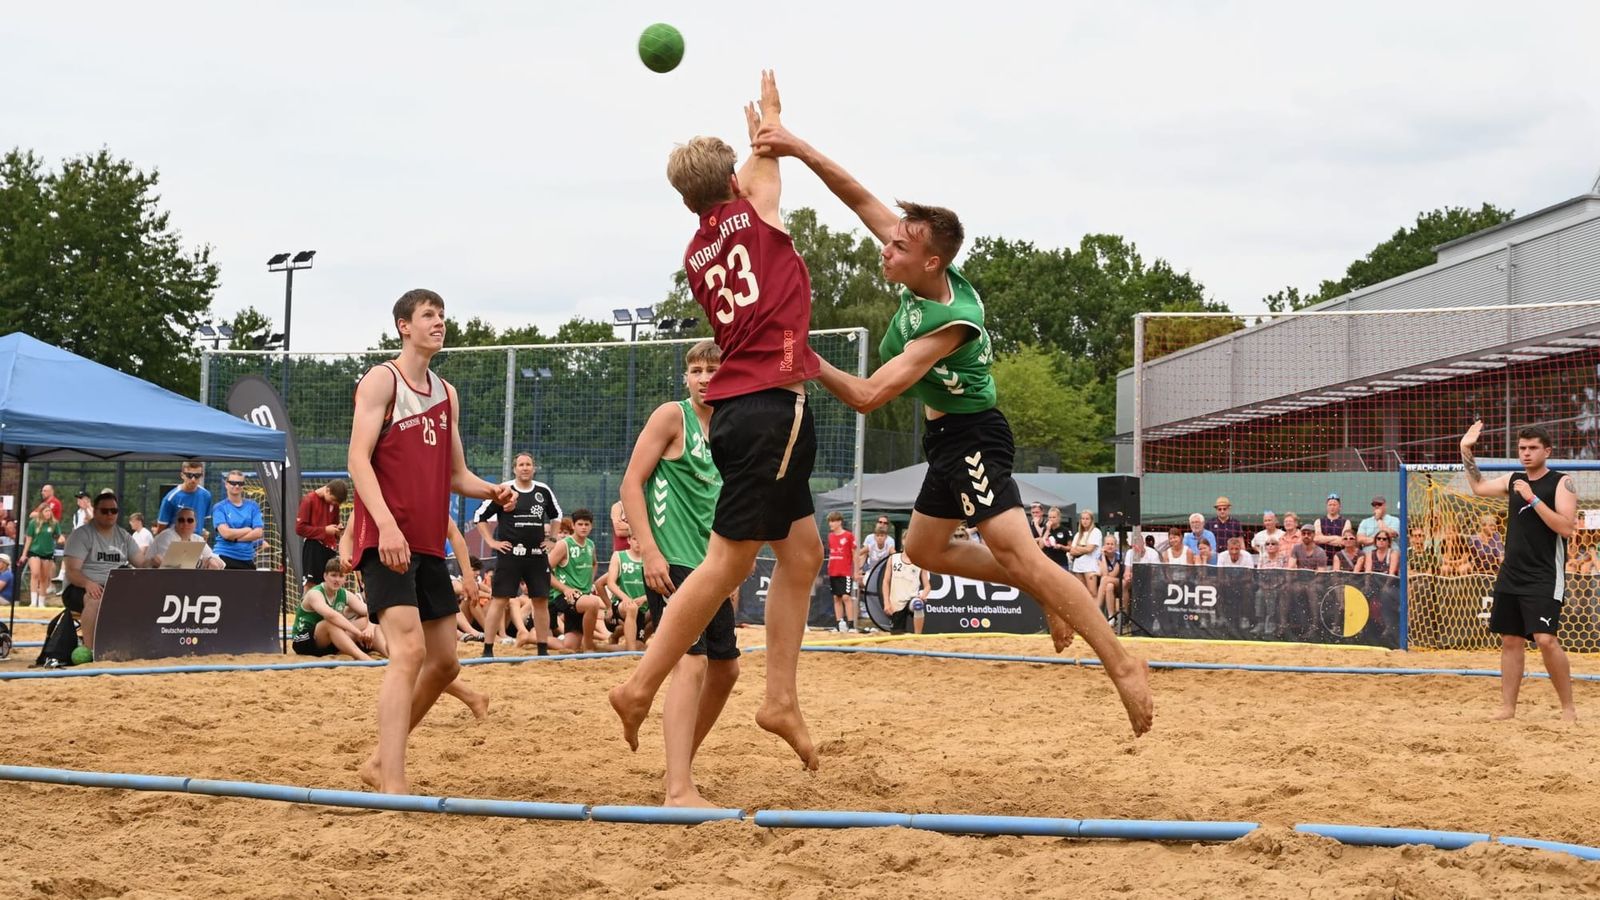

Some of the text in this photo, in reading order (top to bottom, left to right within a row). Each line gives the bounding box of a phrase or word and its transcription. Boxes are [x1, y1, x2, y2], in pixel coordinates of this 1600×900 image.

[704, 243, 760, 325] 33
[421, 415, 437, 446] 26
[960, 492, 976, 517] 8
[621, 562, 635, 574] 95
[1163, 583, 1218, 607] DHB
[156, 594, 222, 624] DHB
[925, 603, 1022, 615] Deutscher Handballbund
